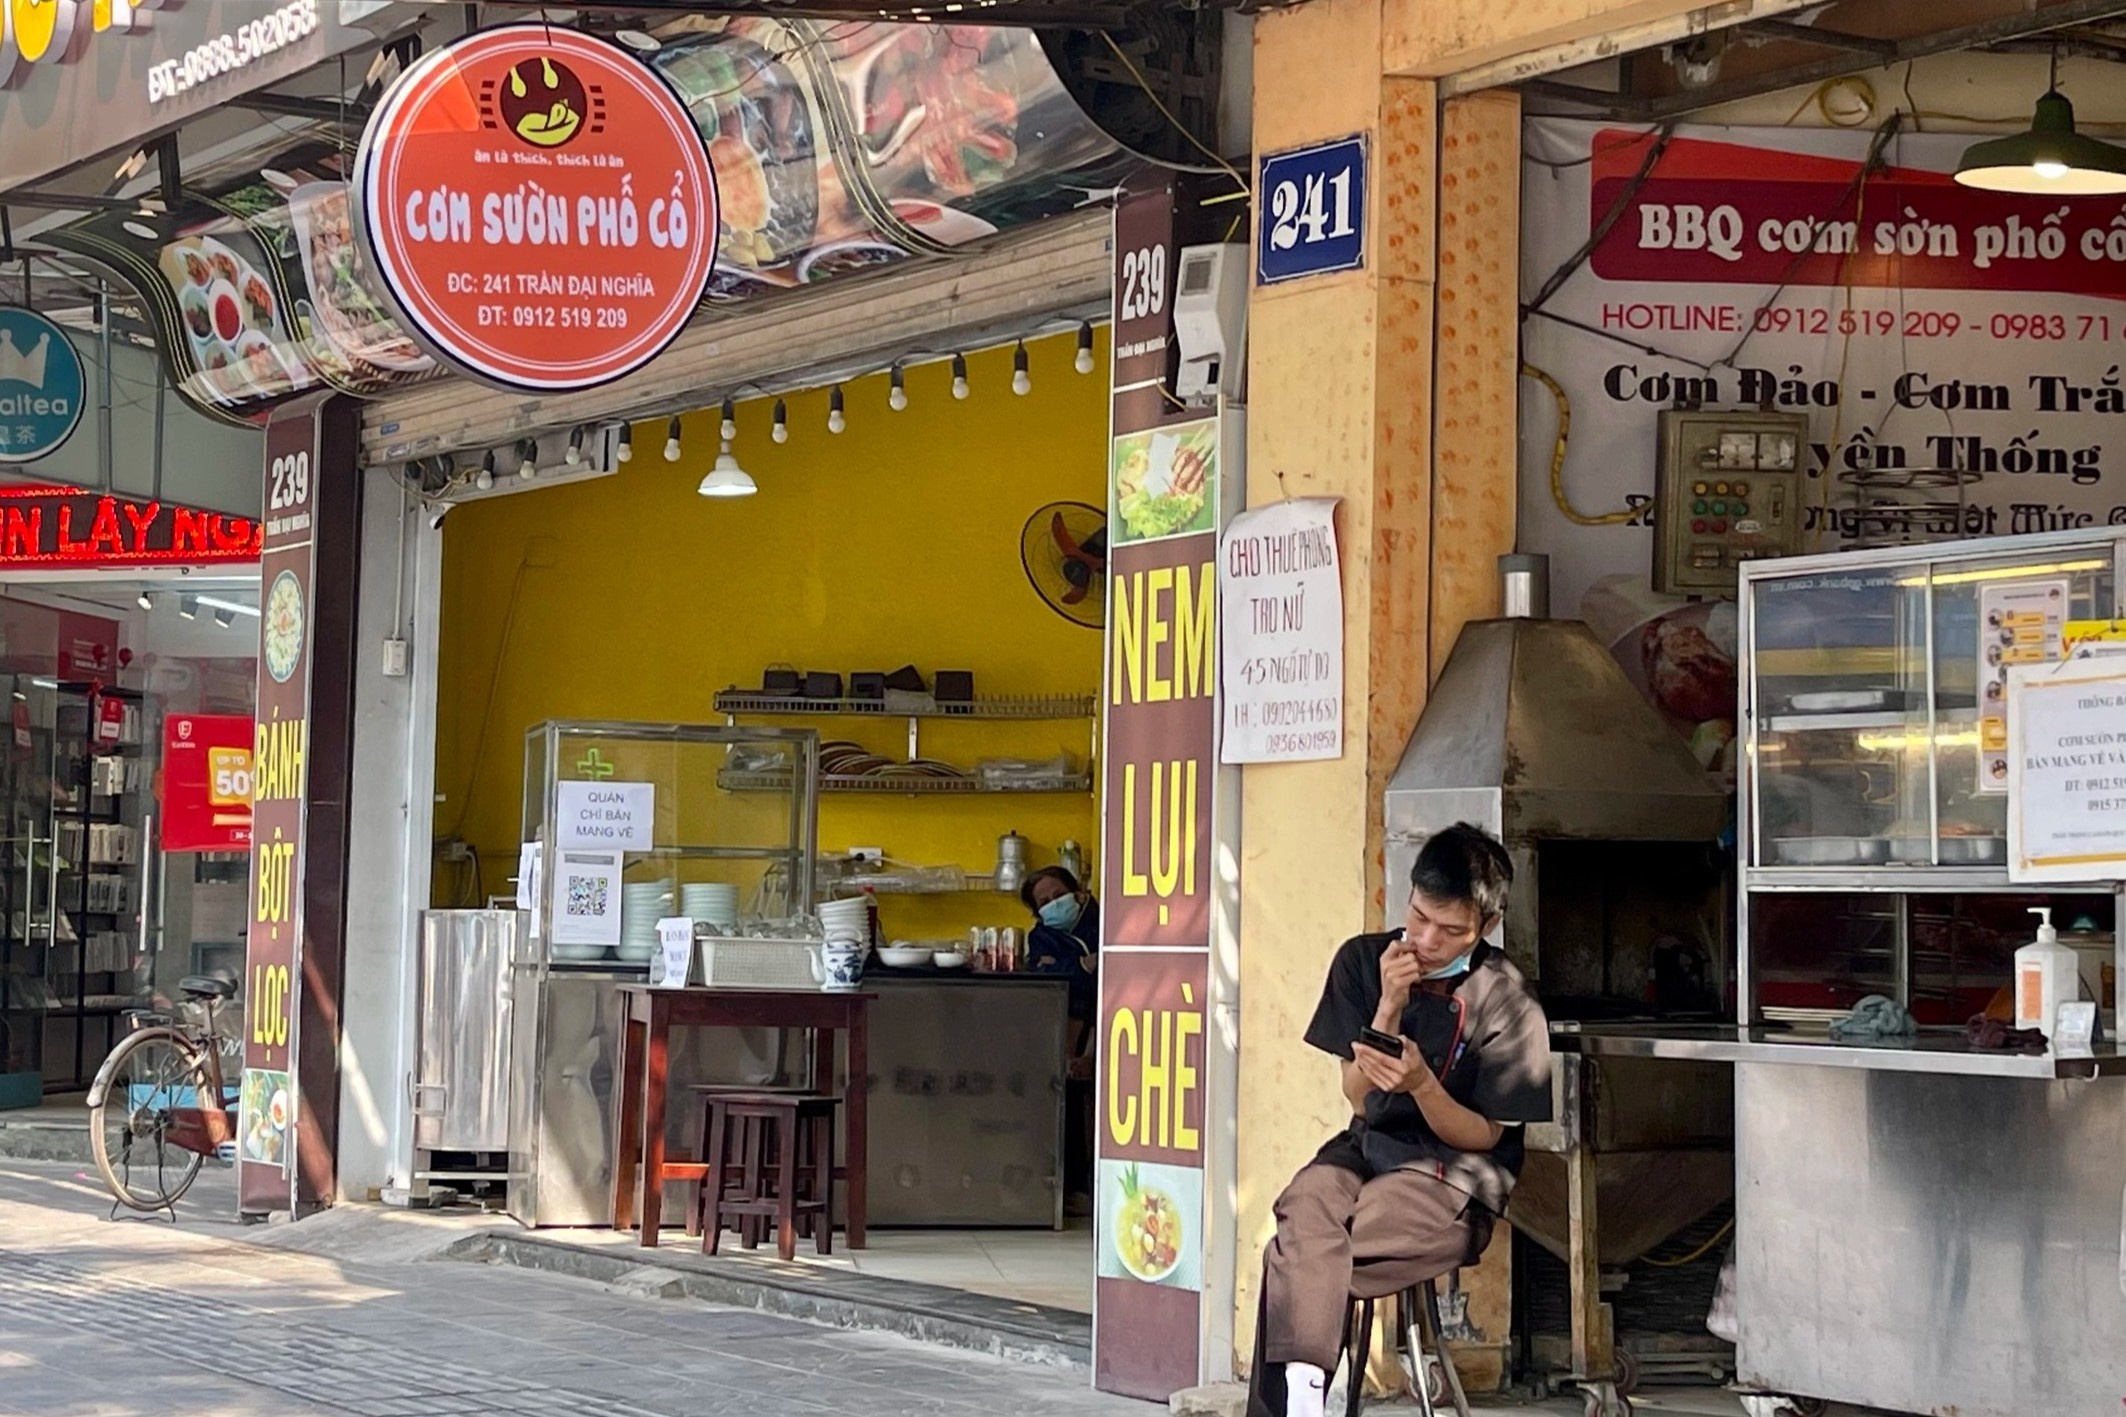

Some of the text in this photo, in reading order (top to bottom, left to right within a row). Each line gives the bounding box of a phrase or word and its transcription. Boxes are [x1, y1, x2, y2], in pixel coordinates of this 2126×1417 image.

[405, 169, 688, 248] CƠM SƯỜN PHỐ CỔ
[1271, 165, 1355, 252] 241
[1638, 203, 1744, 262] BBQ
[1757, 214, 1859, 254] cơm
[1874, 205, 1960, 257] sờn
[1972, 205, 2071, 269] phố
[447, 269, 655, 300] ĐC: 241 TRẦN ĐẠI NGHĨA
[478, 304, 627, 329] ĐT: 0912 519 209
[1121, 243, 1166, 321] 239
[1602, 303, 1743, 332] HOTLINE:
[1753, 307, 1828, 334] 0912
[1838, 309, 1895, 336] 519
[1903, 312, 1961, 338] 209
[1990, 314, 2066, 341] 0983
[2076, 316, 2110, 342] 71
[1603, 364, 1719, 403] Cơm
[1737, 365, 1841, 407] Đảo
[1893, 371, 2012, 411] Cơm
[271, 450, 309, 510] 239
[1925, 428, 2103, 486] Thống
[1229, 536, 1261, 578] CHO
[1112, 561, 1215, 706] NEM
[1240, 657, 1266, 686] 45
[255, 705, 305, 801] BÁNH
[1121, 759, 1198, 926] LỤI
[257, 826, 295, 941] BỘT
[253, 963, 289, 1063] LỌC
[1108, 982, 1203, 1151] CHÈ
